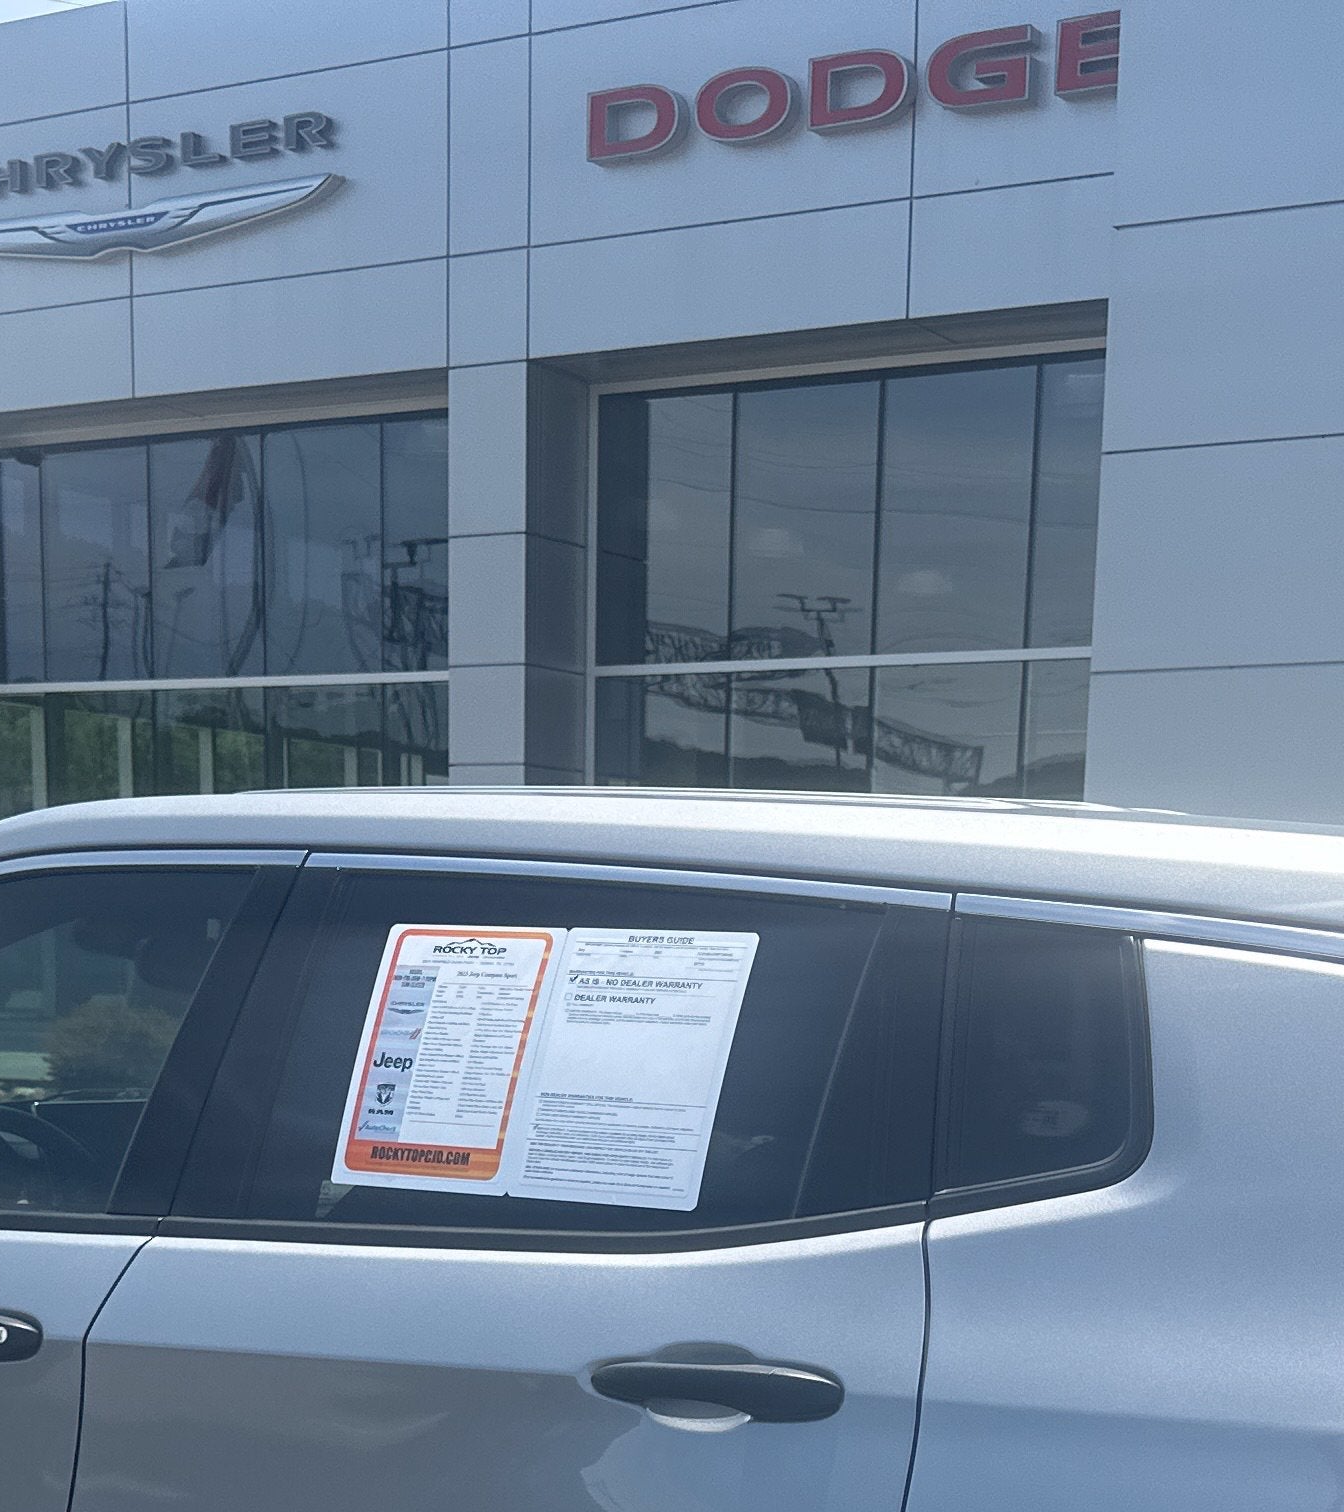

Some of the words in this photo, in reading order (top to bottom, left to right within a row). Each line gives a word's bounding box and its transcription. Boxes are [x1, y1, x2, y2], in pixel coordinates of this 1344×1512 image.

[586, 9, 1122, 162] DODGE
[76, 216, 155, 232] CHRYSLER
[666, 936, 695, 945] GUIDE
[433, 945, 477, 954] ROCKY
[480, 946, 507, 955] TOP
[578, 977, 590, 985] AS
[620, 979, 654, 988] DEALER
[655, 981, 703, 989] WARRANTY
[574, 994, 607, 1002] DEALER
[609, 995, 656, 1004] WARRANTY
[373, 1052, 413, 1072] Jeep
